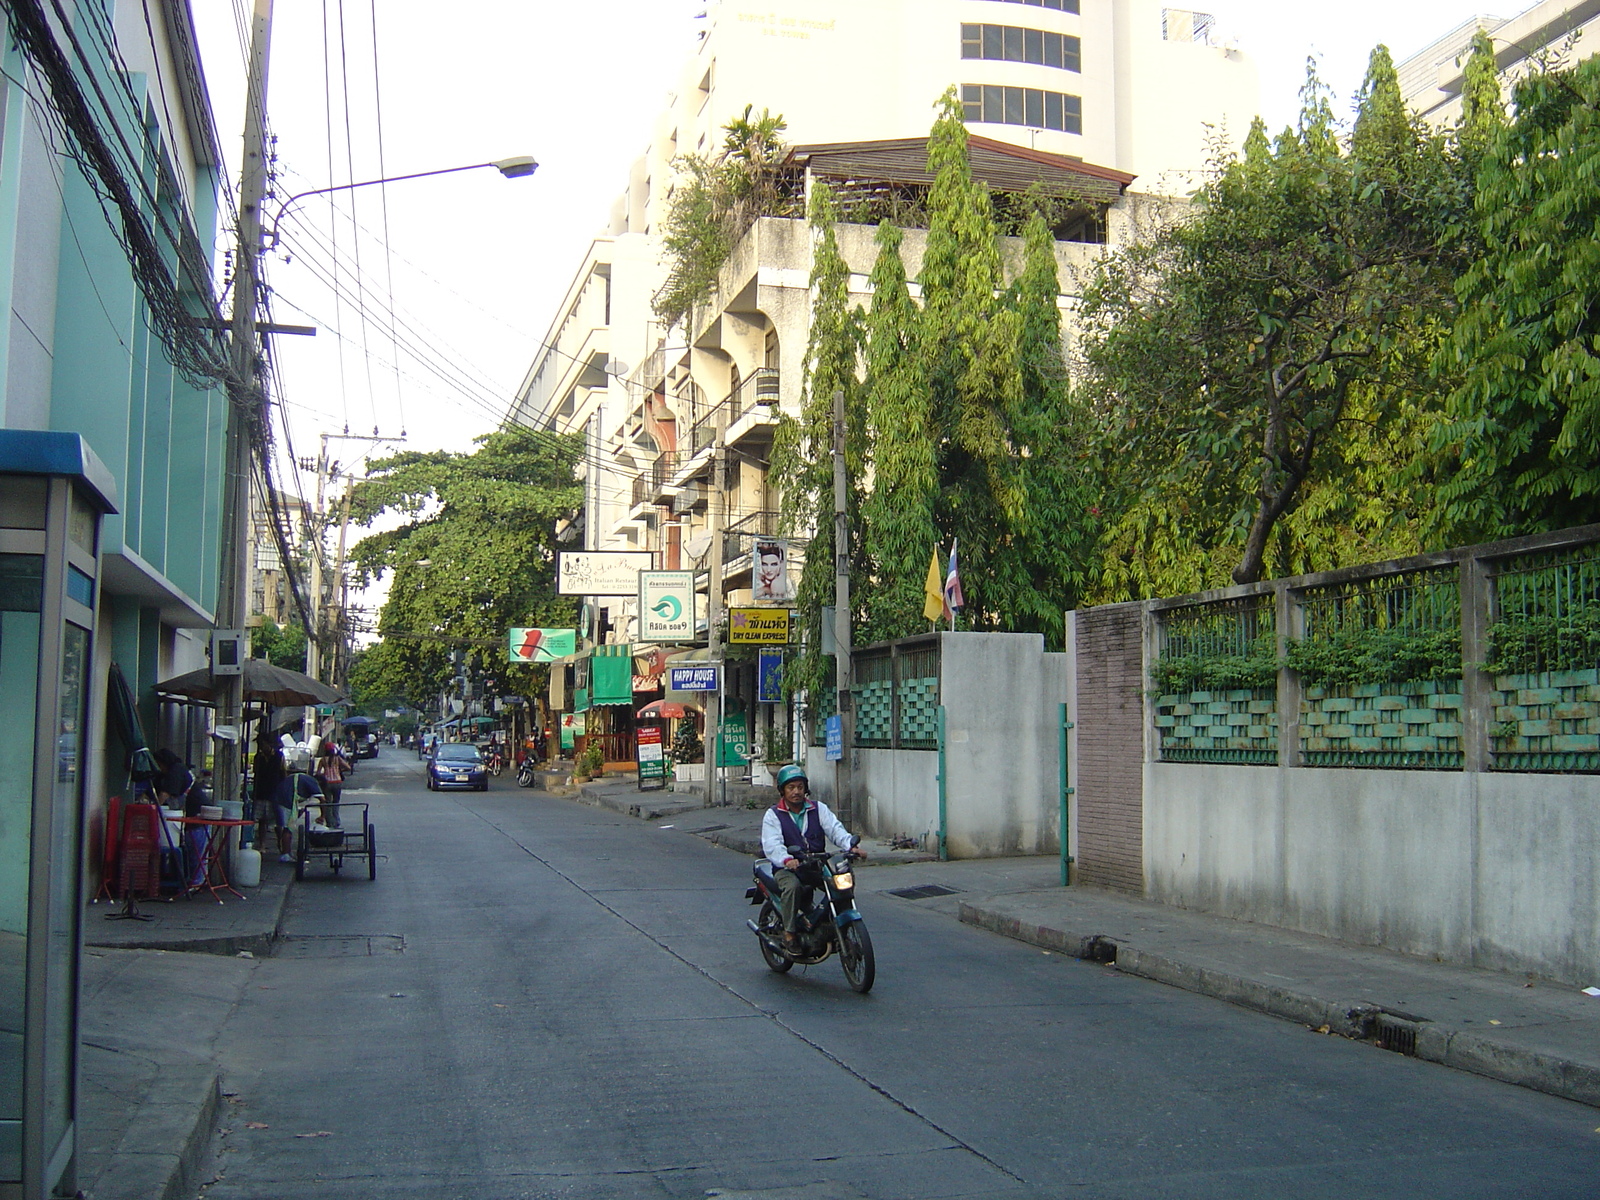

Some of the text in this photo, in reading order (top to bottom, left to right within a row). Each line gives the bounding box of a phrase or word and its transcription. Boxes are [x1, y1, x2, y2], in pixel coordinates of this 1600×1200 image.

[733, 631, 786, 640] DRY CLEAN EXPRESS
[674, 669, 714, 682] HAPPY HOUSE
